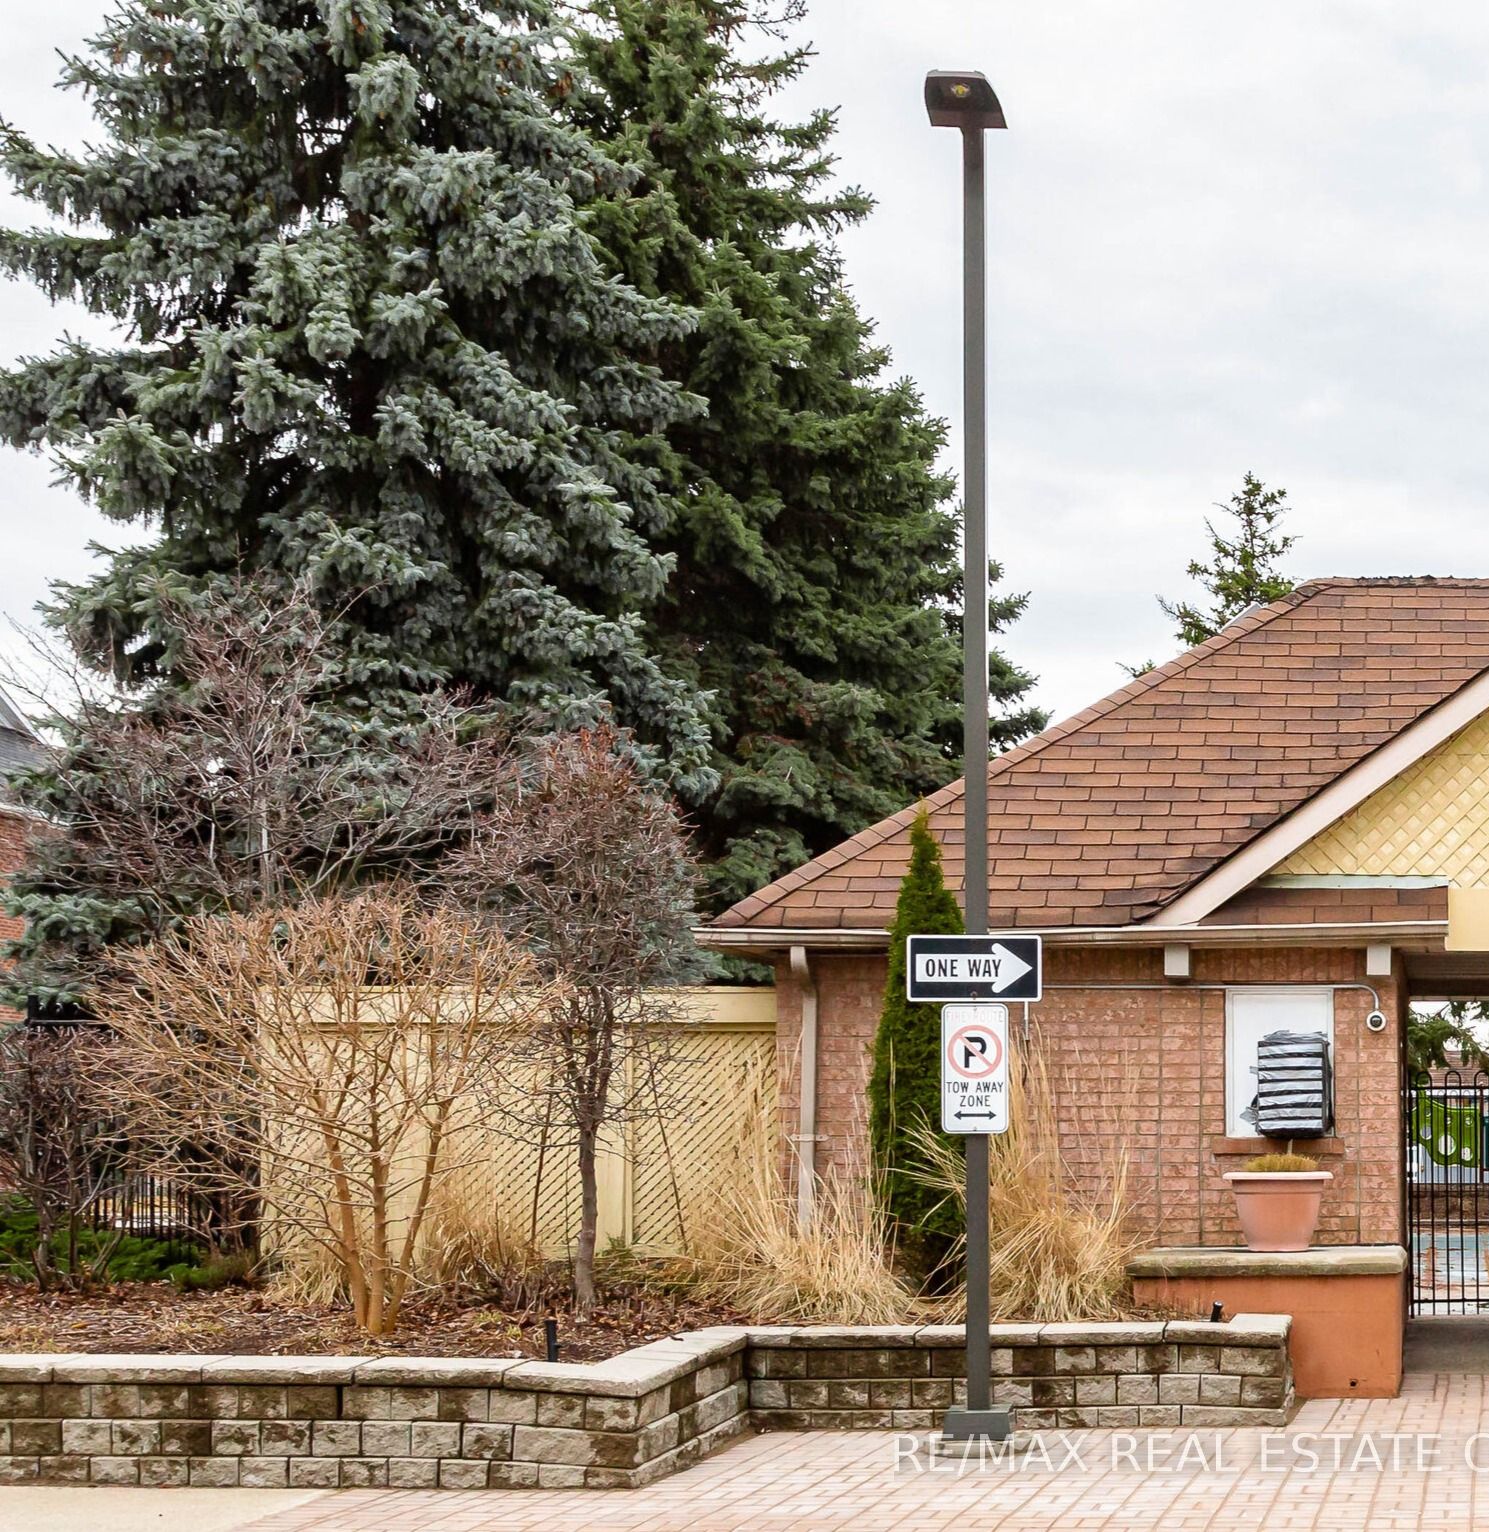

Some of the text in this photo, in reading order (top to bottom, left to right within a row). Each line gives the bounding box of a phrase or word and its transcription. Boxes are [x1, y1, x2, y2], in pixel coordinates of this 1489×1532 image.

[925, 958, 1002, 977] ONE WAY
[946, 1081, 1004, 1093] TOW AWAY
[959, 1095, 991, 1107] ZONE
